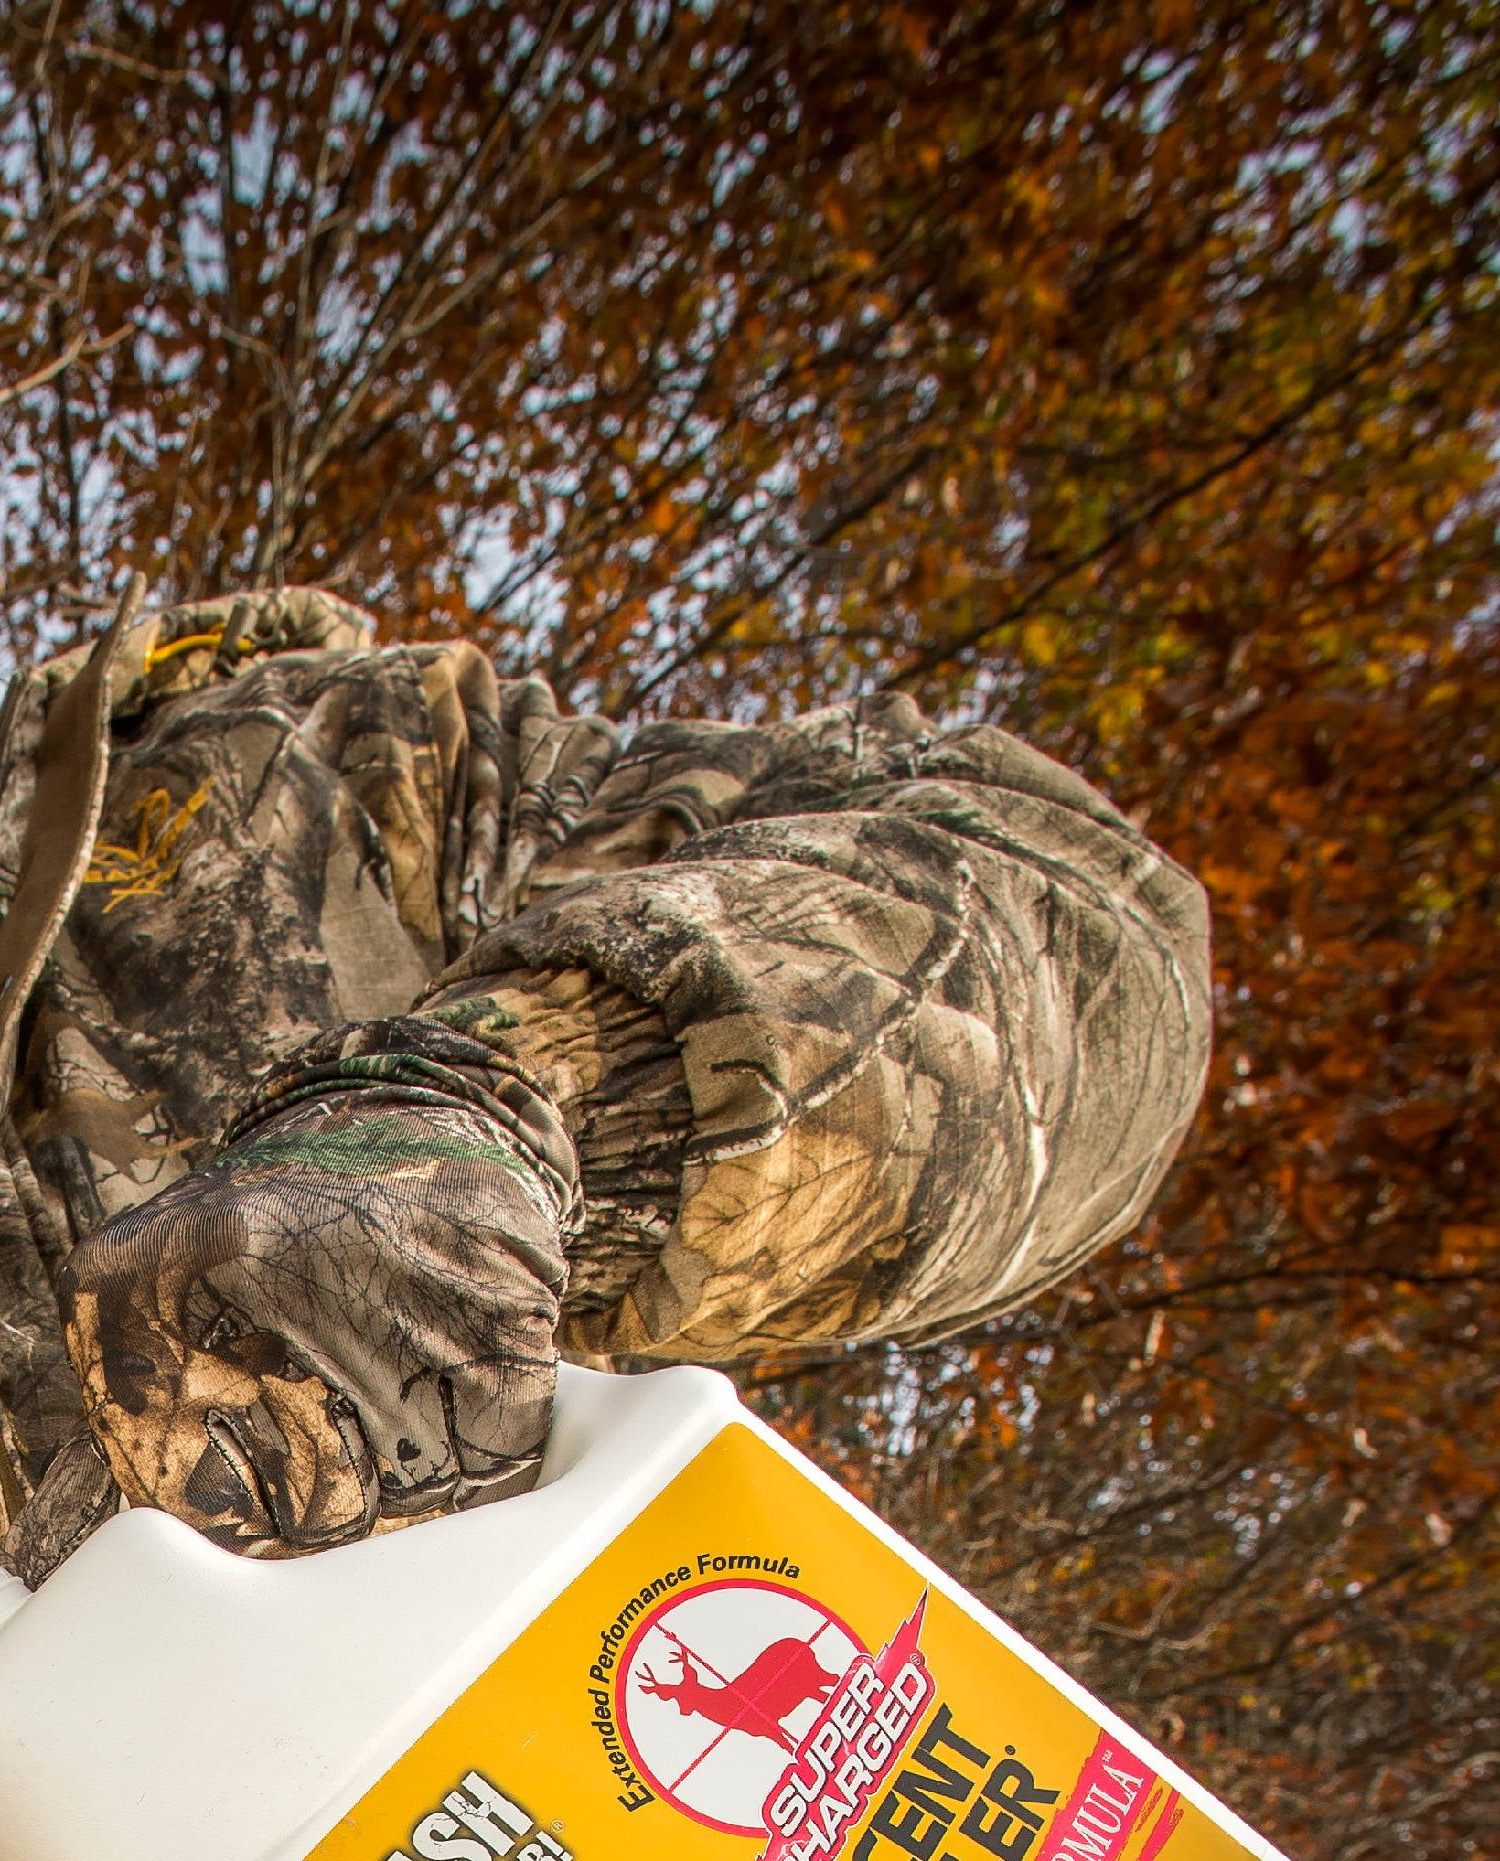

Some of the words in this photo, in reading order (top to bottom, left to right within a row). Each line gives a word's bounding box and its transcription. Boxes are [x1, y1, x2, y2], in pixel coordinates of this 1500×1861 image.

[589, 1563, 692, 1685] Performance
[696, 1553, 801, 1579] Formula
[587, 1688, 656, 1813] Extended
[771, 1664, 884, 1834] SUPER
